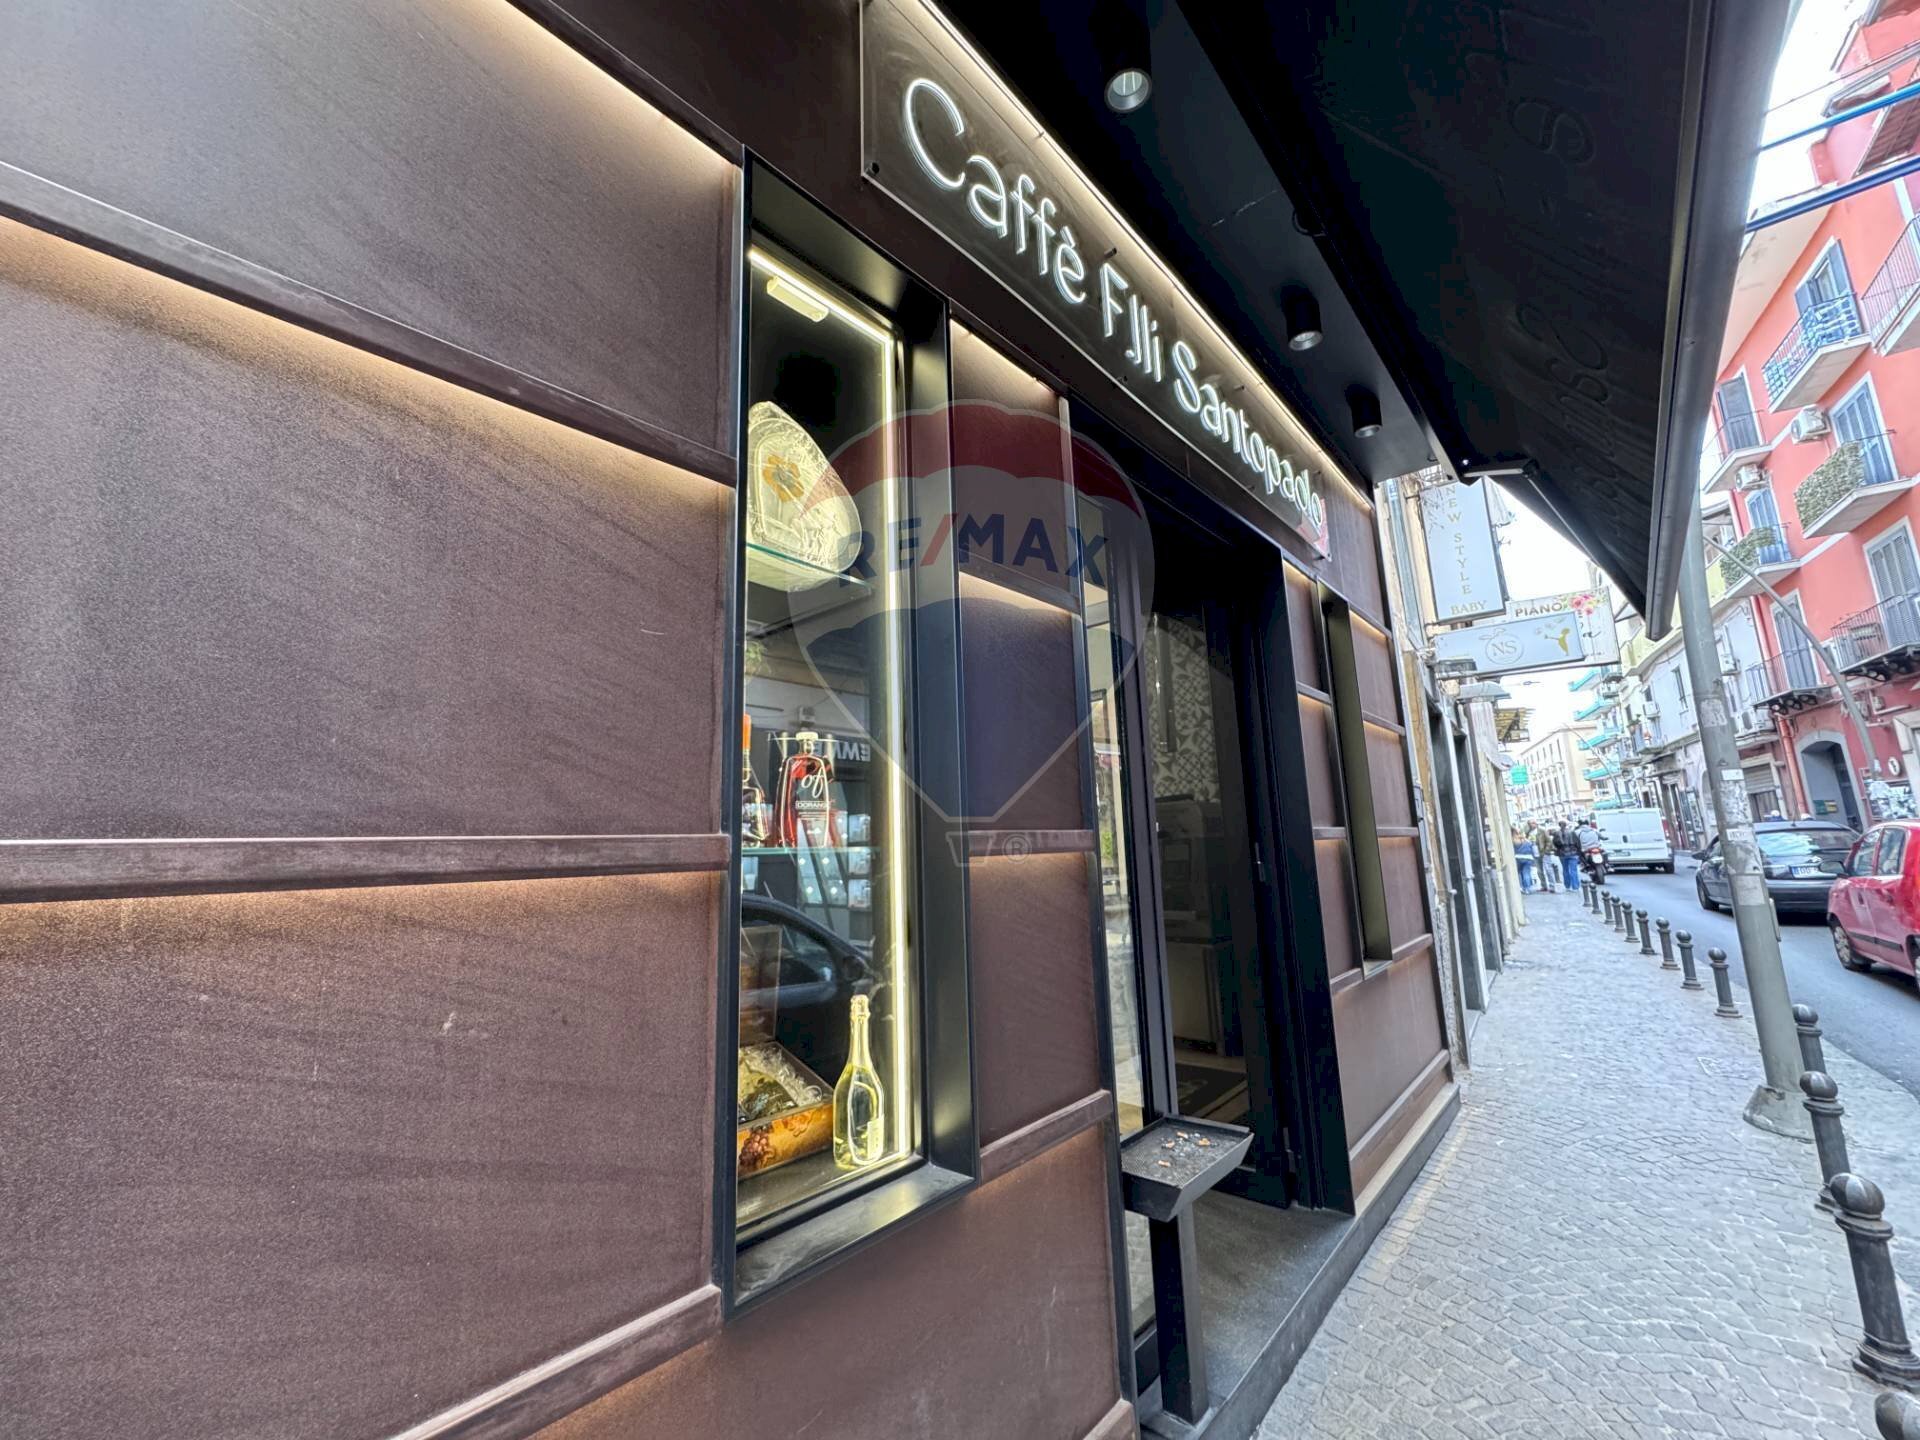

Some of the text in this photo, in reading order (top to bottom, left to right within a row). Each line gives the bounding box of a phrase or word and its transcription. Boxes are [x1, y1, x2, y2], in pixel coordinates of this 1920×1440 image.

[904, 78, 1086, 303] Caffè
[1099, 263, 1162, 383] F.lli
[1171, 340, 1322, 526] Santopaolo
[1446, 485, 1473, 595] NEW STYLE
[1450, 599, 1488, 616] BABY
[1515, 602, 1562, 618] PIANO
